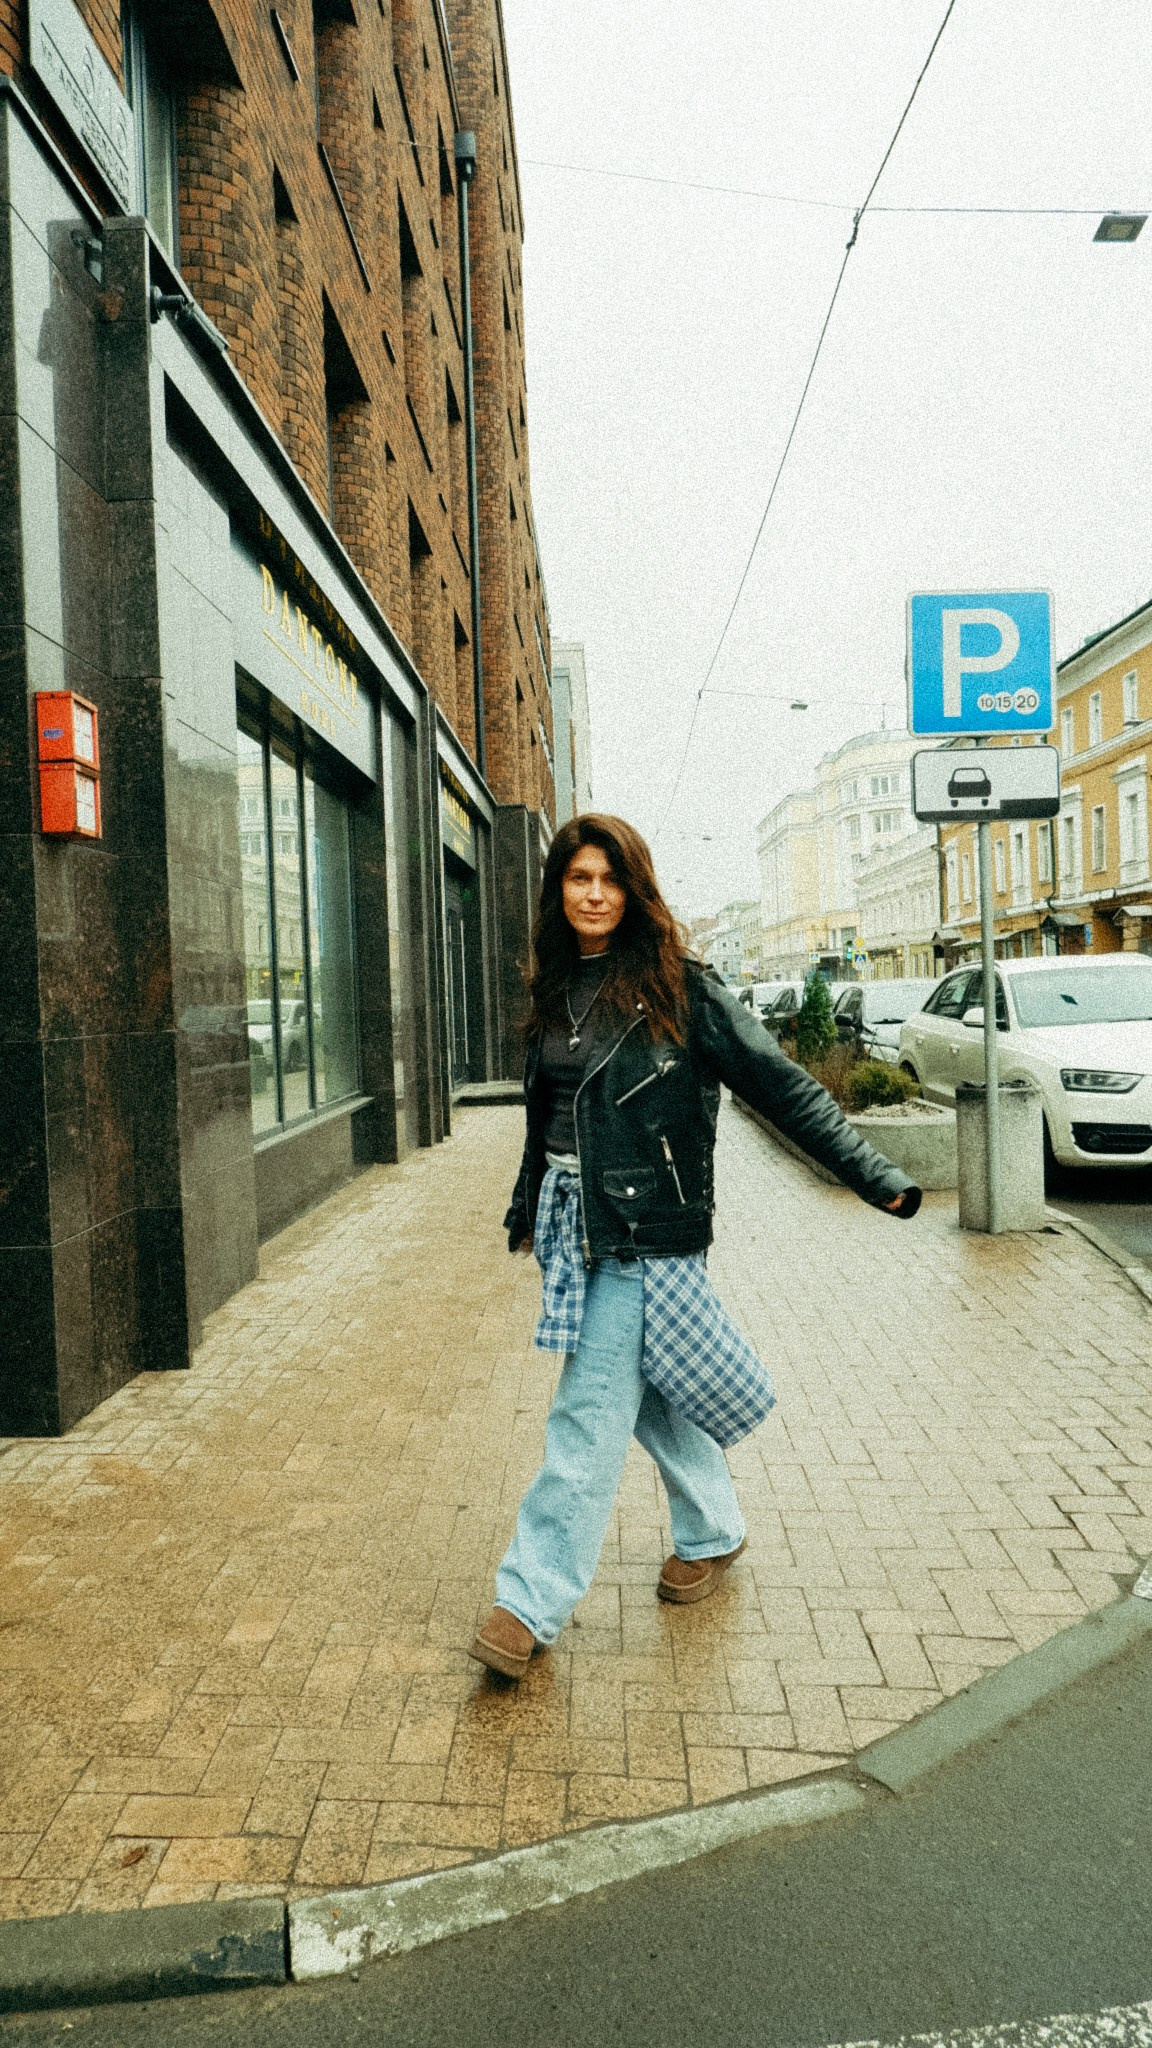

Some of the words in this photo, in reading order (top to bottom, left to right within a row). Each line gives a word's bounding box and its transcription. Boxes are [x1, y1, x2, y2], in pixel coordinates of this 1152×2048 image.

[942, 608, 1019, 717] P
[981, 697, 995, 708] 10
[998, 696, 1012, 708] 15
[1016, 694, 1037, 708] 20
